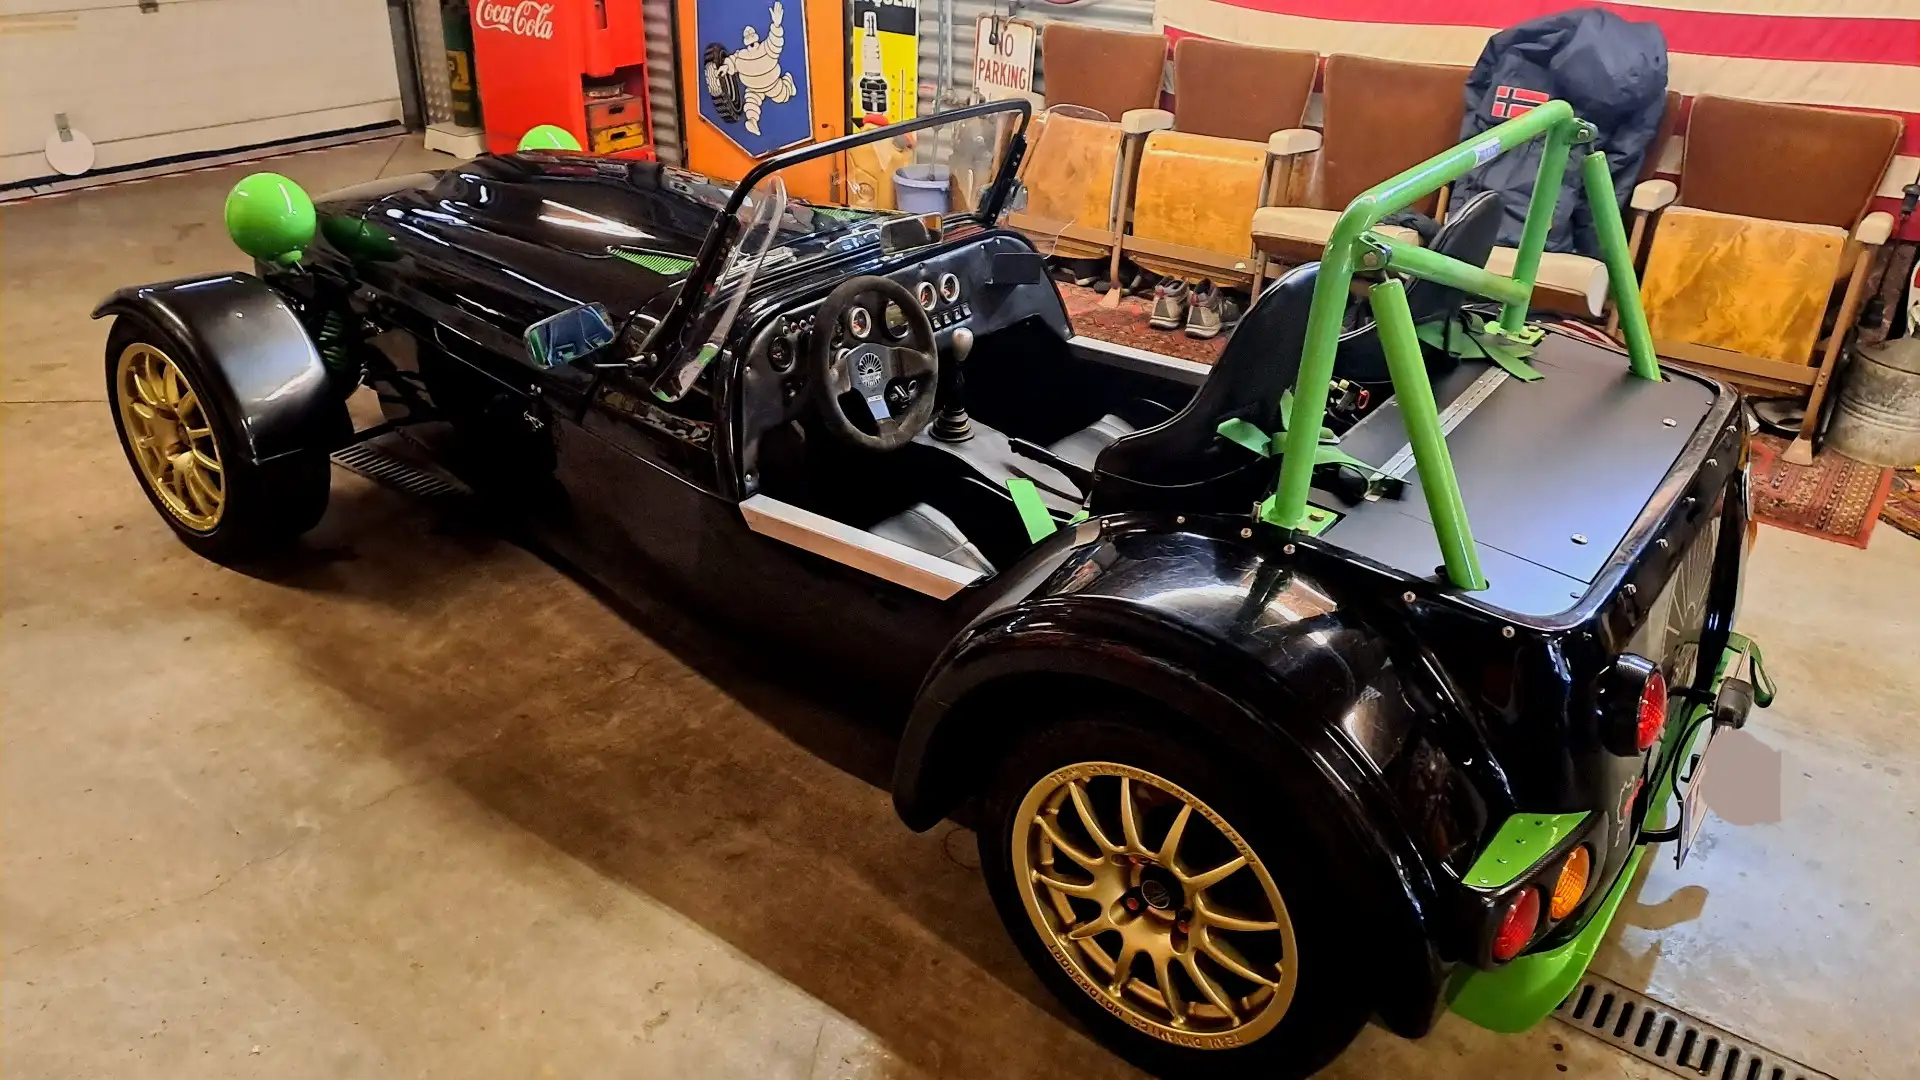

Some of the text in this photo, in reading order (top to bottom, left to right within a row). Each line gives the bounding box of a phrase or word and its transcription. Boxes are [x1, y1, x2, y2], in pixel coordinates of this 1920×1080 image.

[993, 31, 1014, 57] NO
[978, 58, 1027, 90] PARKING
[1048, 943, 1124, 1018] MOTORSPORT
